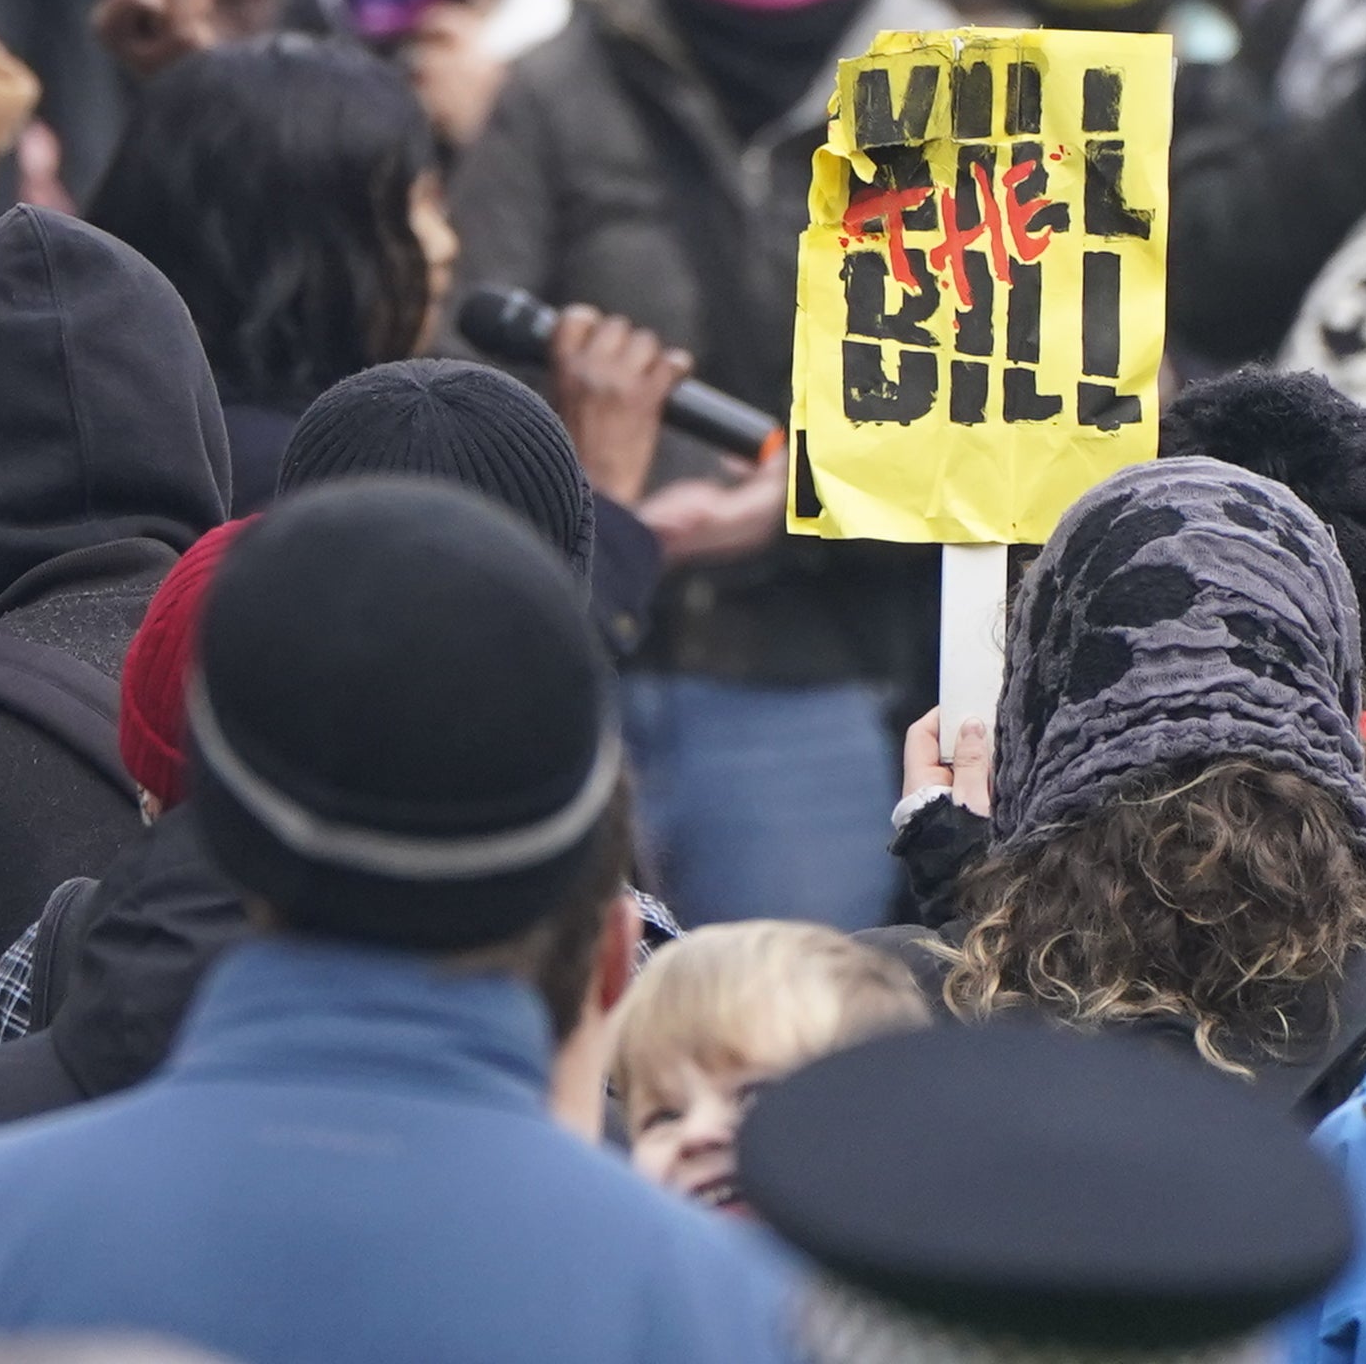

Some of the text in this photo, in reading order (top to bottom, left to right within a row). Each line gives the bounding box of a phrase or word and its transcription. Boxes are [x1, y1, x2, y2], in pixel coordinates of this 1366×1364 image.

[840, 156, 1054, 310] THE
[848, 61, 1155, 240] KILL
[839, 248, 1143, 433] BILL
